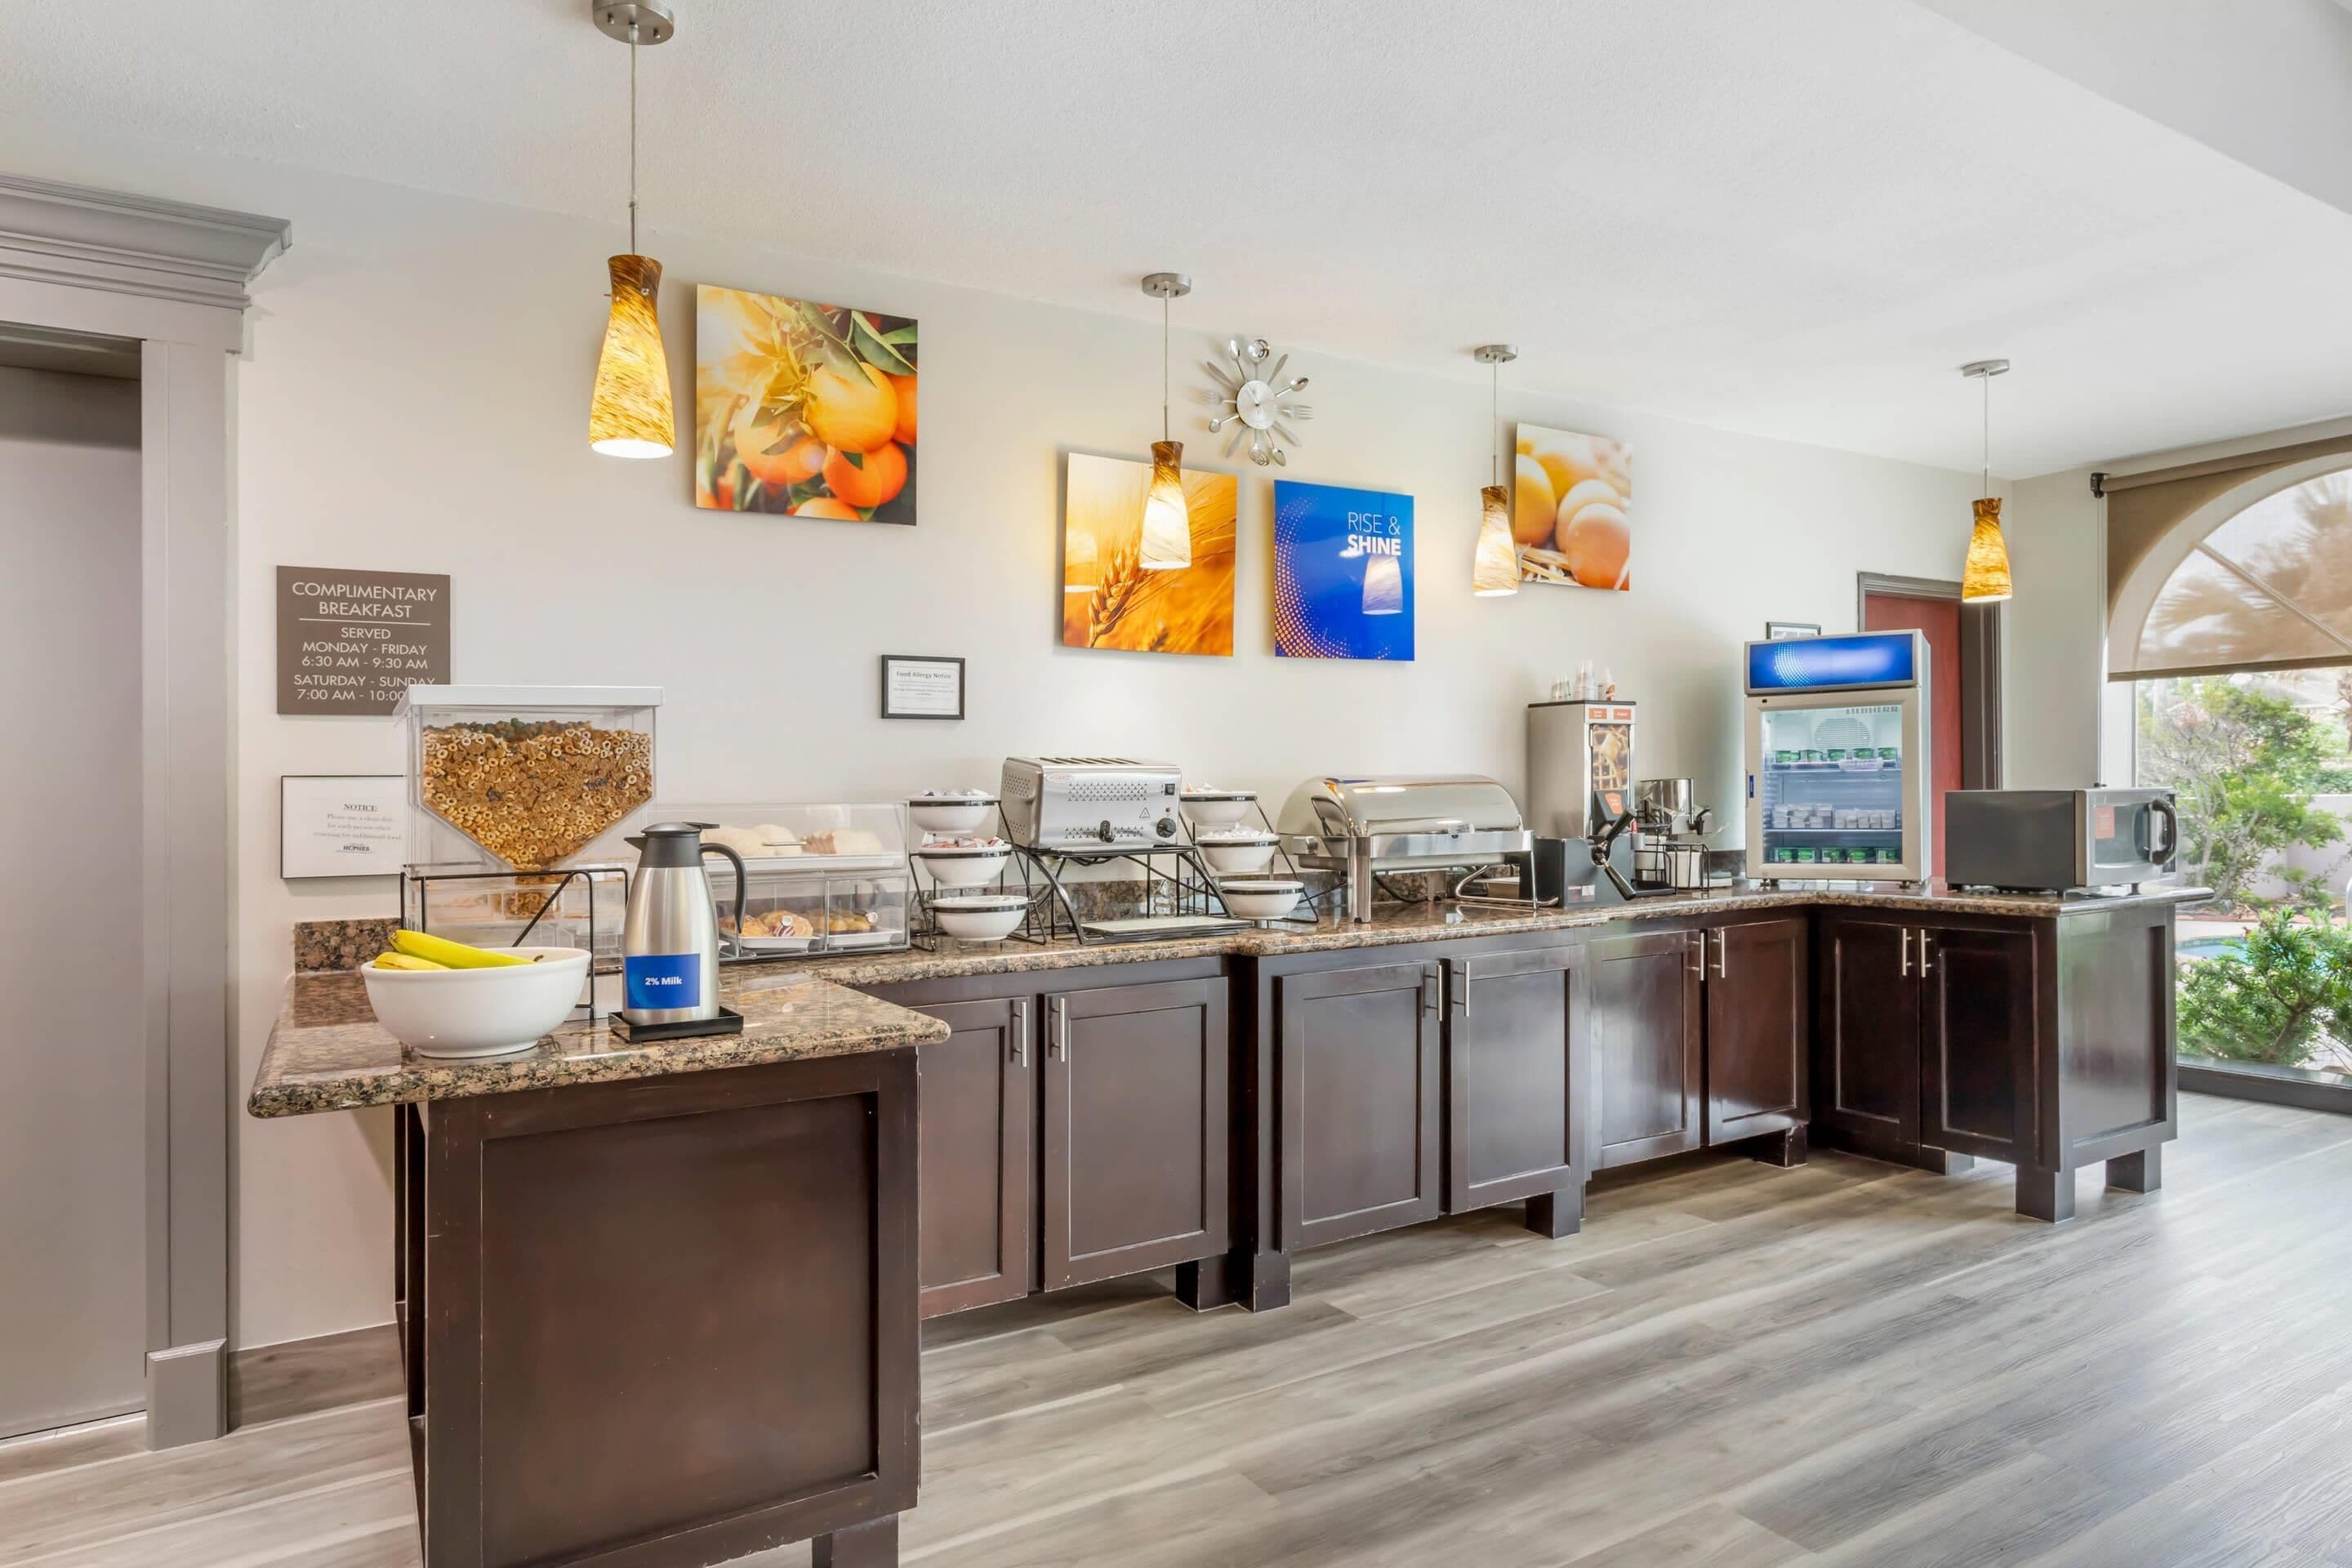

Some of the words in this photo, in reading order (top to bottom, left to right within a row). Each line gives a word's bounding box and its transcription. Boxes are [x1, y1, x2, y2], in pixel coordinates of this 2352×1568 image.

[1348, 511, 1383, 533] RISE
[1388, 515, 1401, 535] &
[1347, 534, 1402, 556] SHINE
[292, 581, 437, 602] COMPLIMENTARY
[318, 601, 412, 618] BREAKFAST
[341, 626, 391, 639] SERVED
[302, 641, 368, 654] MONDAY
[381, 643, 428, 656] FRIDAY
[301, 655, 332, 667] 6:30
[336, 657, 359, 667] AM
[372, 657, 402, 669] 9:30
[405, 658, 428, 670] AM
[293, 675, 367, 687] SATURDAY
[379, 675, 436, 687] SUNDAY
[296, 688, 327, 700] 7:00
[332, 689, 355, 701] AM
[644, 977, 660, 986] 2%
[661, 976, 683, 985] Milk
